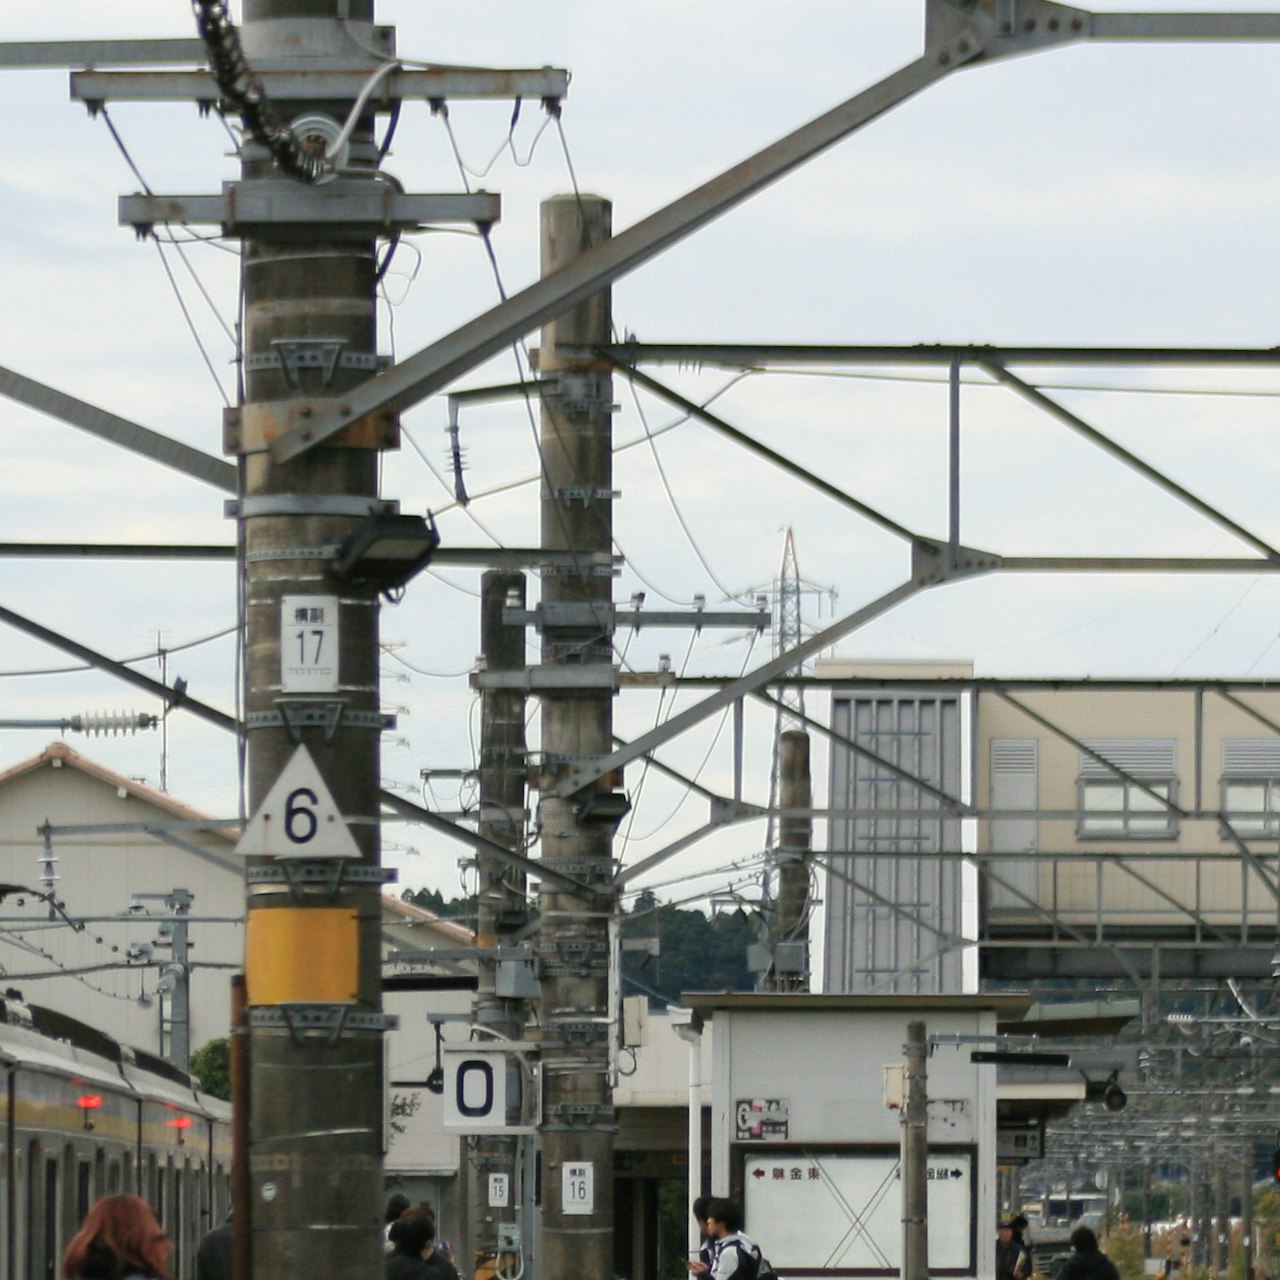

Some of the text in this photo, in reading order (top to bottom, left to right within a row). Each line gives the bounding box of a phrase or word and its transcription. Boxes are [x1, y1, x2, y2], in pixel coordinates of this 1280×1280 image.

[296, 630, 324, 665] 17
[284, 787, 318, 845] 6
[456, 1060, 494, 1117] 0
[493, 1185, 505, 1198] 15
[570, 1180, 586, 1200] 16
